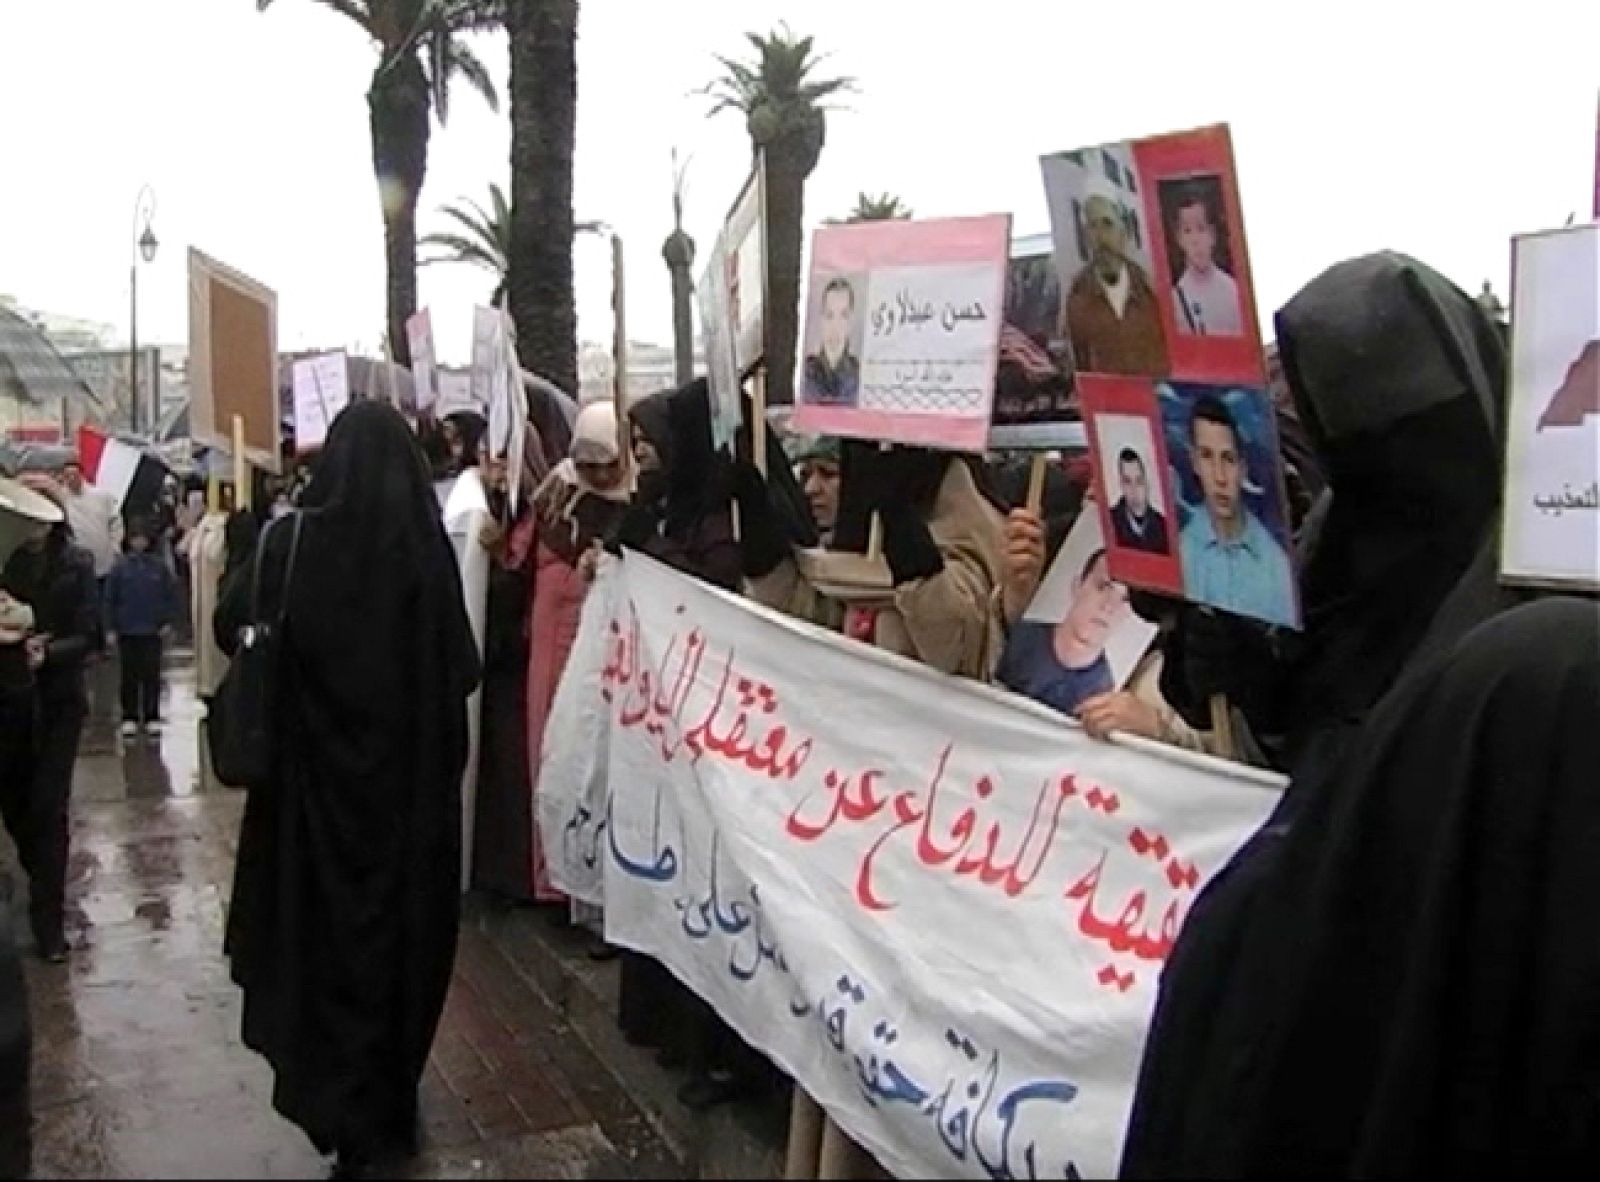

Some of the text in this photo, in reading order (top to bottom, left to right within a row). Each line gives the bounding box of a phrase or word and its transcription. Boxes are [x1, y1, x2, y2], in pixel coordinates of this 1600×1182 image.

[941, 301, 987, 331] حسن
[785, 768, 890, 840] عن
[856, 740, 1080, 911] للدفاع
[1064, 784, 1200, 993] قيقة
